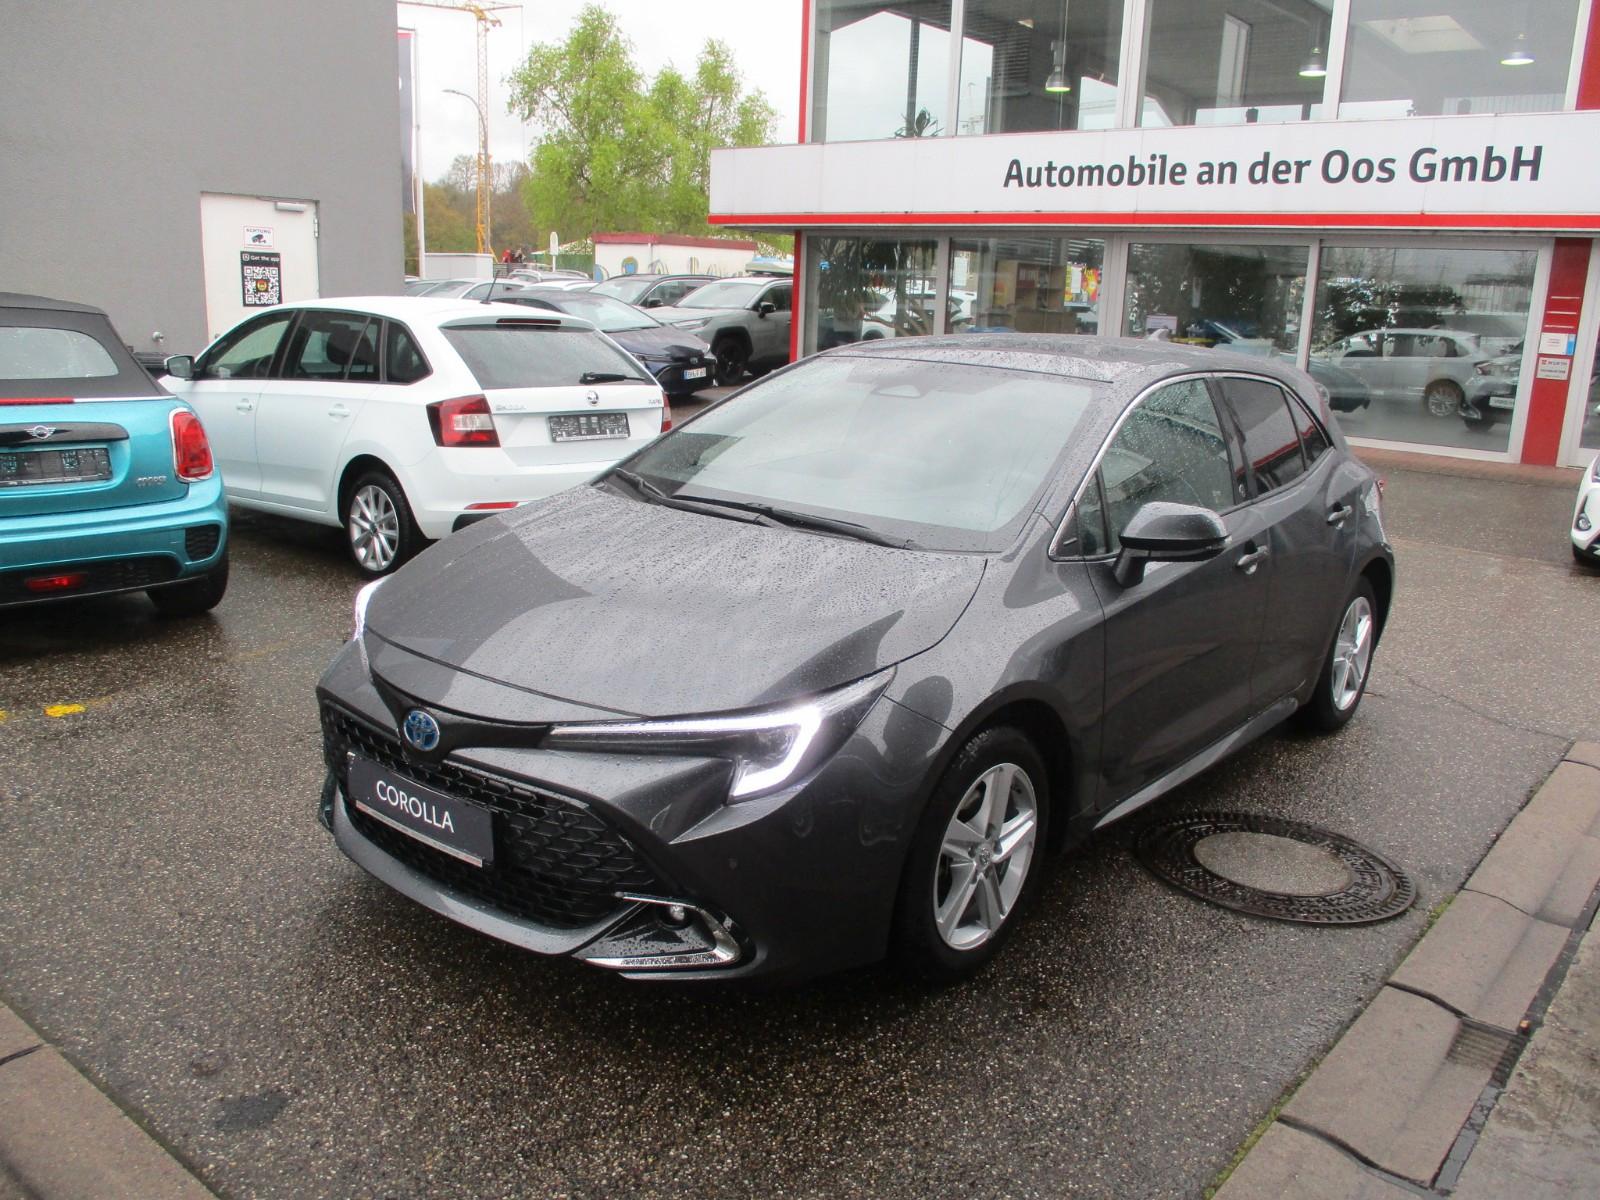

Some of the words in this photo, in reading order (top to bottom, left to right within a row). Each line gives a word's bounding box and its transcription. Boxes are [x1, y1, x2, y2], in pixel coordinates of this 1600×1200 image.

[1003, 153, 1187, 188] Automobile
[1196, 160, 1238, 185] an
[1248, 151, 1312, 185] der
[1321, 149, 1397, 184] Oos
[1408, 145, 1543, 183] GmbH
[376, 780, 455, 833] COROLLA
